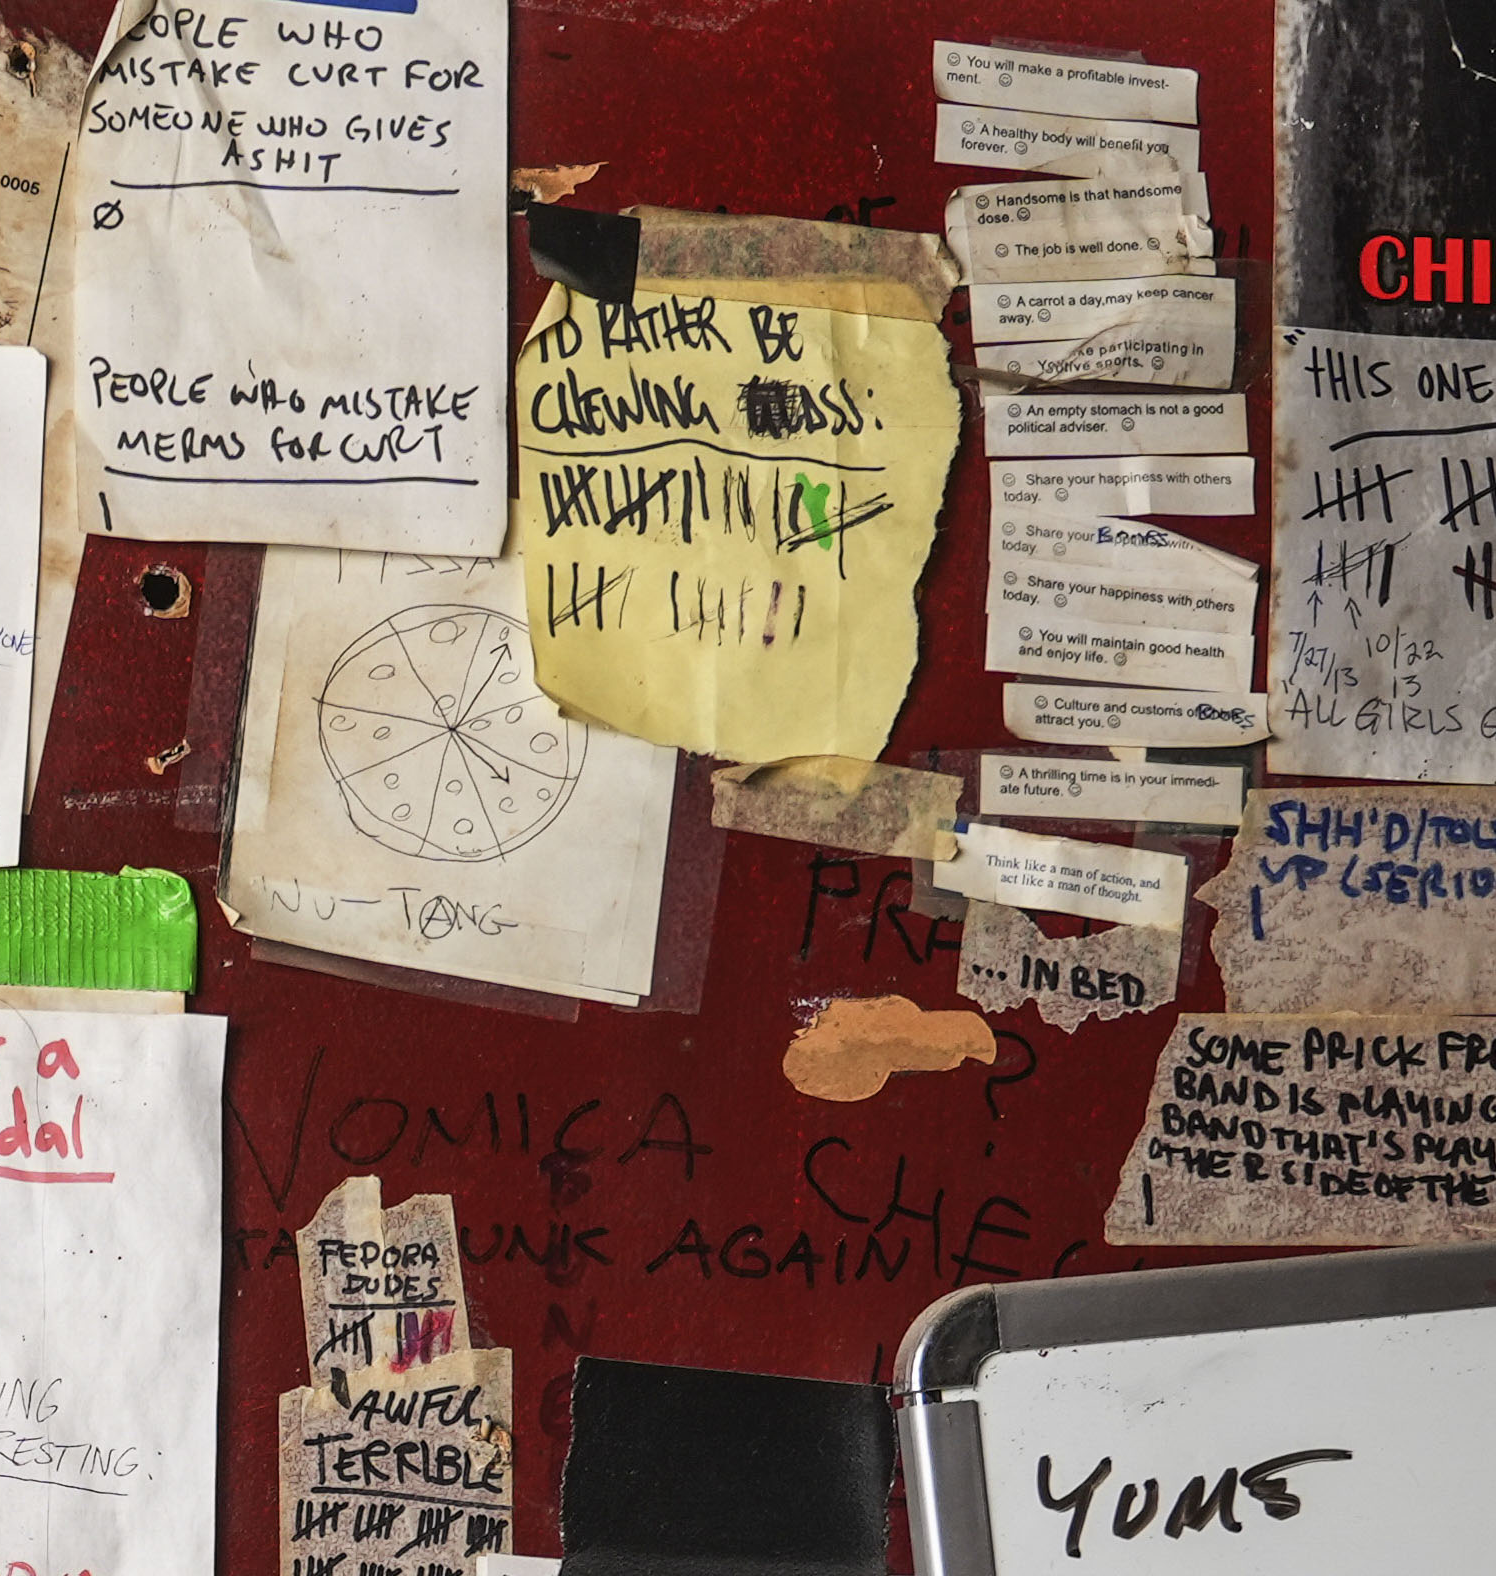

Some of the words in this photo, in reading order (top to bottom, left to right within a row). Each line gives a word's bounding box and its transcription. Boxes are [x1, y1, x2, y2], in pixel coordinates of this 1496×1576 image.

[125, 8, 249, 50] EOPLE
[279, 23, 383, 50] WHO
[98, 57, 260, 86] MISTAKE
[288, 62, 387, 88] CURT
[405, 60, 484, 91] FOR
[947, 72, 981, 84] ment.
[966, 56, 990, 70] You
[995, 59, 1015, 72] will
[1018, 61, 1052, 76] make
[1068, 69, 1124, 85] profitable
[1128, 73, 1169, 90] invest-
[89, 101, 246, 137] SOMEONE
[257, 115, 328, 139] WHO
[346, 114, 451, 147] GIVES
[1015, 243, 1039, 255] The
[1042, 243, 1062, 257] job
[1065, 243, 1075, 253] is
[1078, 241, 1104, 253] well
[1106, 239, 1143, 252] done.
[596, 296, 731, 359] RATHER
[749, 305, 804, 363] BE
[89, 356, 214, 408] PEOPLE
[320, 384, 479, 422] MISTAKE
[1008, 421, 1055, 436] political
[1059, 421, 1108, 433] adviser.
[1027, 404, 1045, 416] An
[1048, 406, 1087, 420] empty
[1090, 404, 1142, 416] stomach
[1145, 404, 1156, 415] is
[1160, 404, 1179, 415] not
[1193, 403, 1224, 417] good
[271, 430, 331, 464] FOR
[339, 425, 444, 464] CURT
[1019, 645, 1042, 657] and
[1047, 648, 1082, 663] enjoy
[1085, 651, 1108, 664] life.
[1039, 629, 1064, 642] You
[1066, 633, 1088, 645] will
[1091, 636, 1145, 651] maintain
[1149, 642, 1182, 657] good
[1185, 645, 1225, 658] health
[1021, 954, 1059, 994] IN
[1071, 967, 1145, 1008] BED
[37, 1038, 80, 1079] a
[1187, 1027, 1290, 1075] SOME
[1303, 1027, 1426, 1076] PRICK
[318, 1239, 441, 1277] FEDORA
[342, 1275, 442, 1304] DUDES
[304, 1433, 504, 1495] TERRIBLE
[1036, 1447, 1353, 1559] YUME
